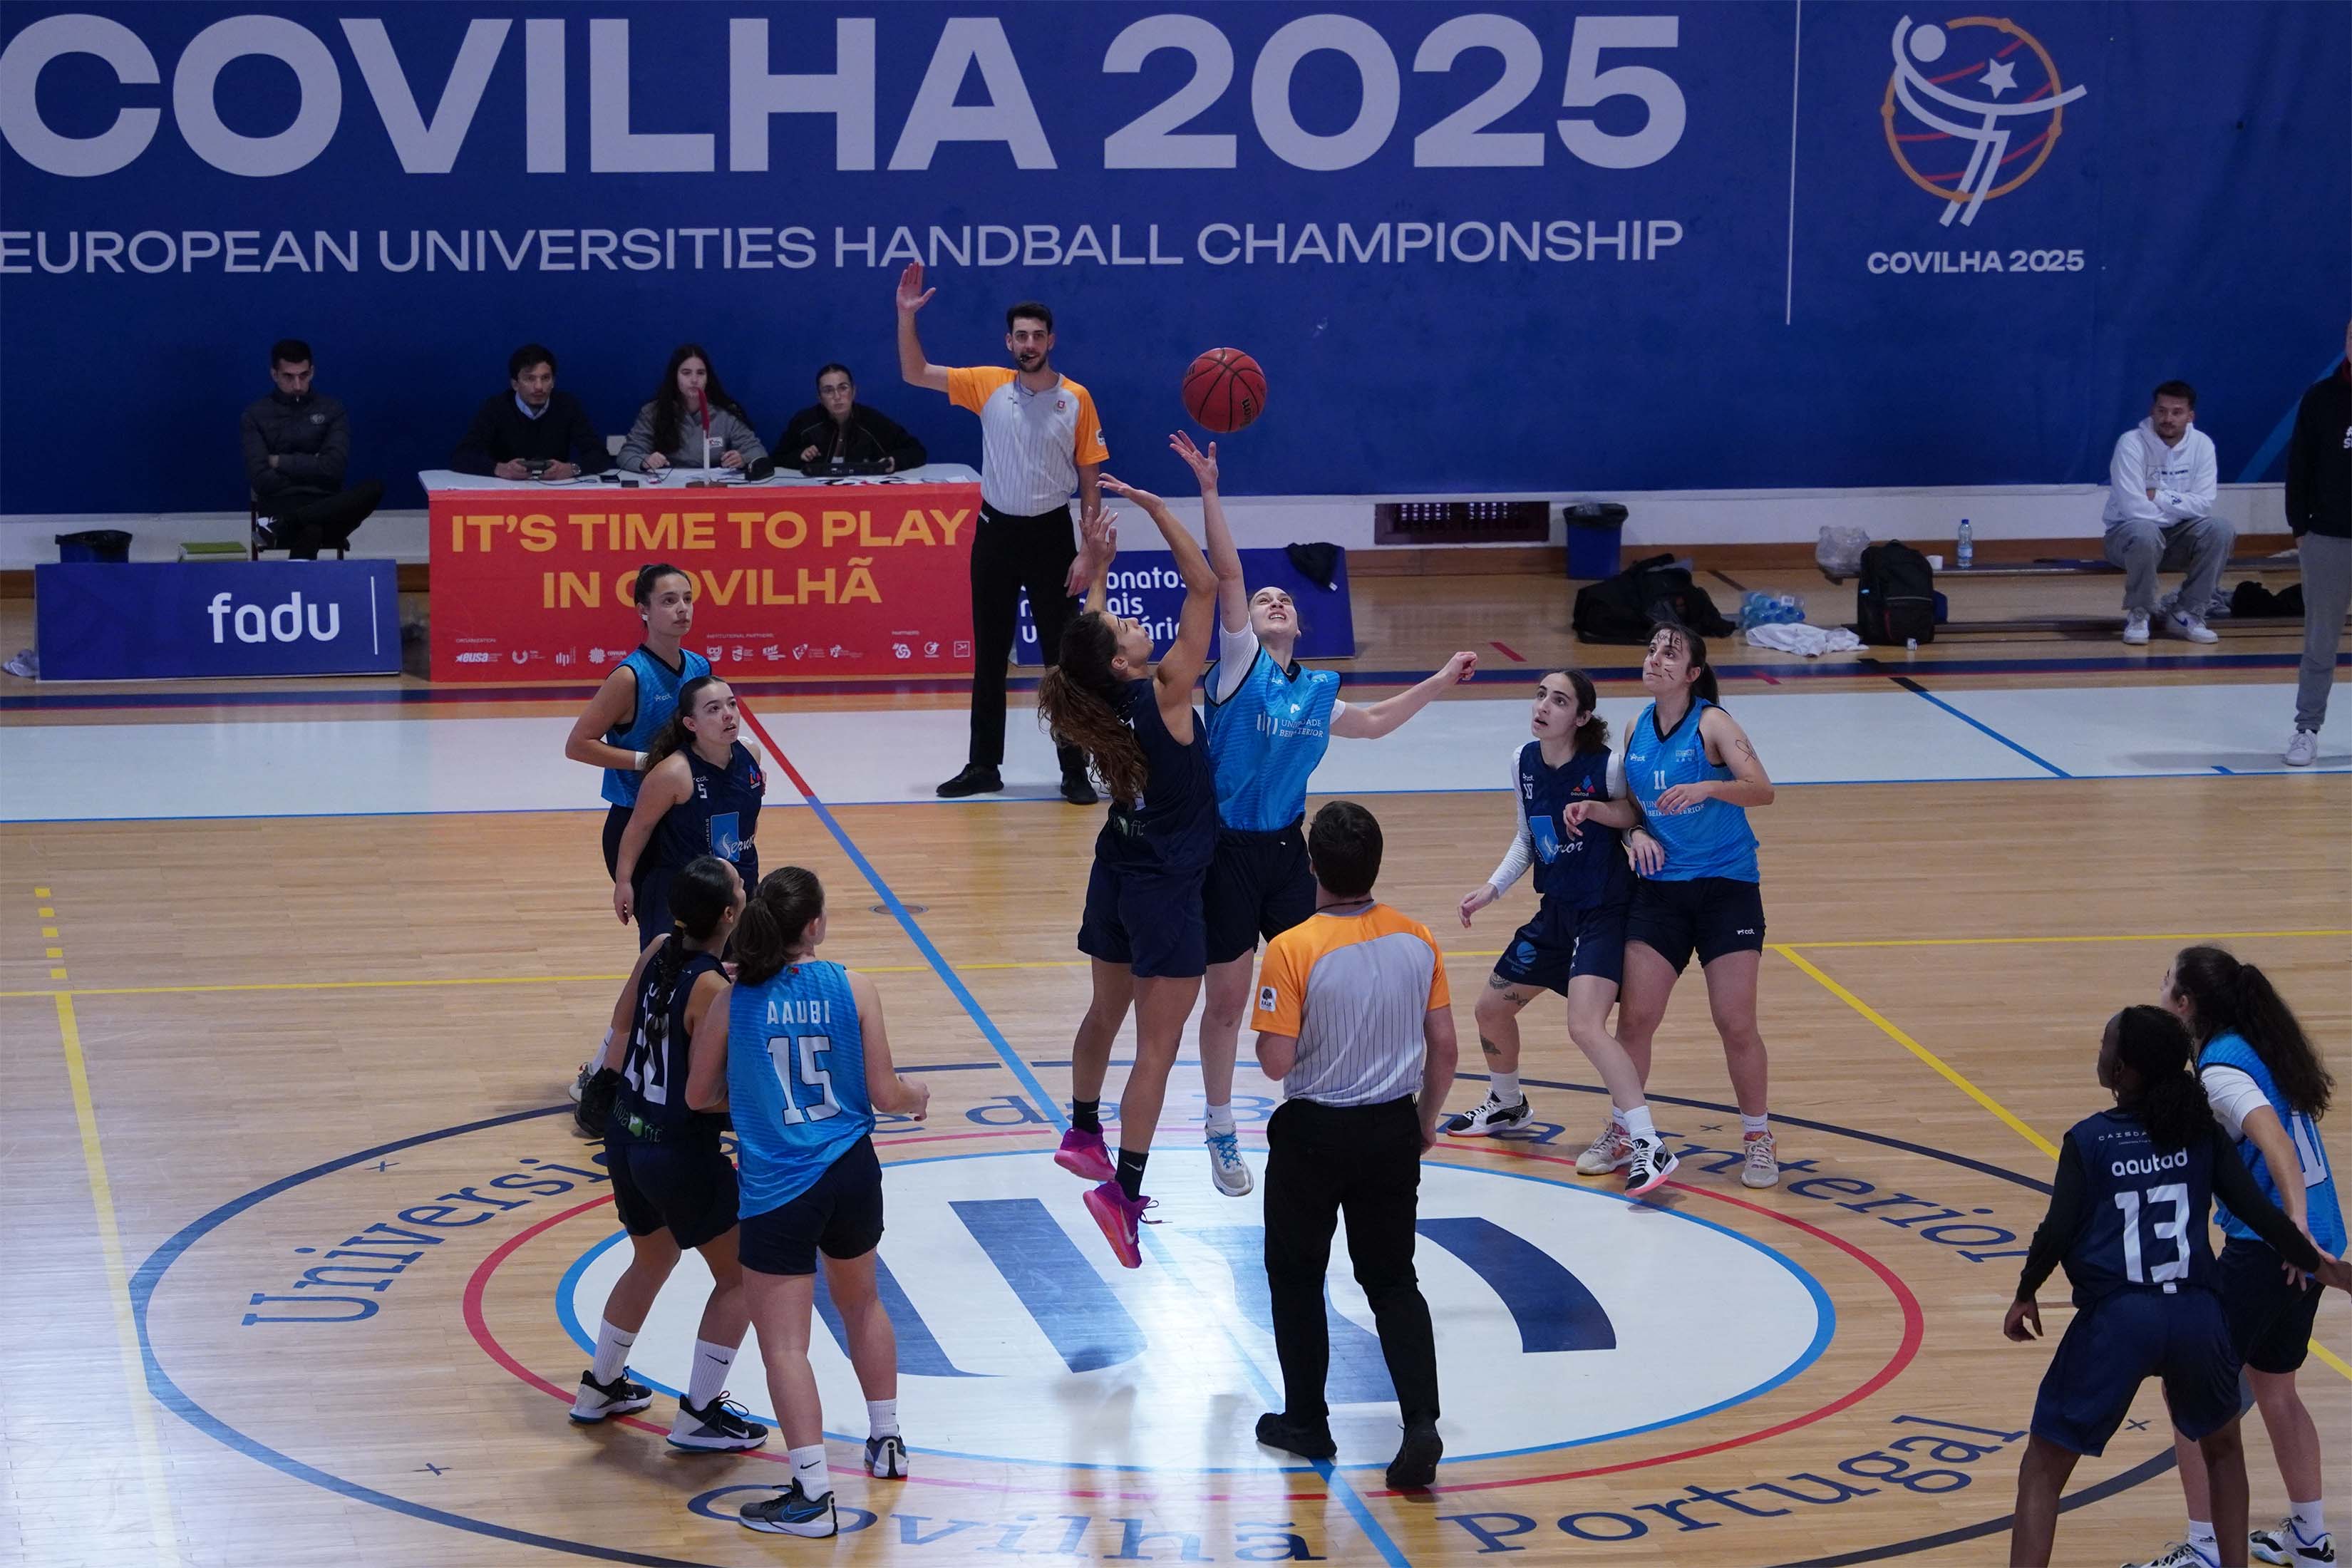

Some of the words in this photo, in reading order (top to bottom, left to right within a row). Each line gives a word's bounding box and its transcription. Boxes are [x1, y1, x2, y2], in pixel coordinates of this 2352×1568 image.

[0, 14, 1058, 177] COVILHA
[1103, 14, 1687, 171] 2025
[0, 230, 359, 274] EUROPEAN
[378, 227, 815, 273] UNIVERSITIES
[835, 224, 1184, 267] HANDBALL
[1197, 220, 1684, 264] CHAMPIONSHIP
[1867, 250, 2003, 274] COVILHA
[2008, 249, 2085, 272] 2025
[452, 513, 557, 553] IT'S
[569, 512, 716, 552] TIME
[728, 510, 808, 550] TO
[823, 509, 971, 547] PLAY
[542, 572, 600, 609] IN
[615, 557, 882, 607] CVILHÃ
[207, 591, 340, 644] fadu
[1654, 770, 1667, 790] 11
[766, 1000, 831, 1025] AAUBI
[766, 1035, 842, 1126] 15
[2111, 1147, 2188, 1177] aautad
[2114, 1182, 2191, 1284] 13
[1435, 1415, 2028, 1554] Portugal
